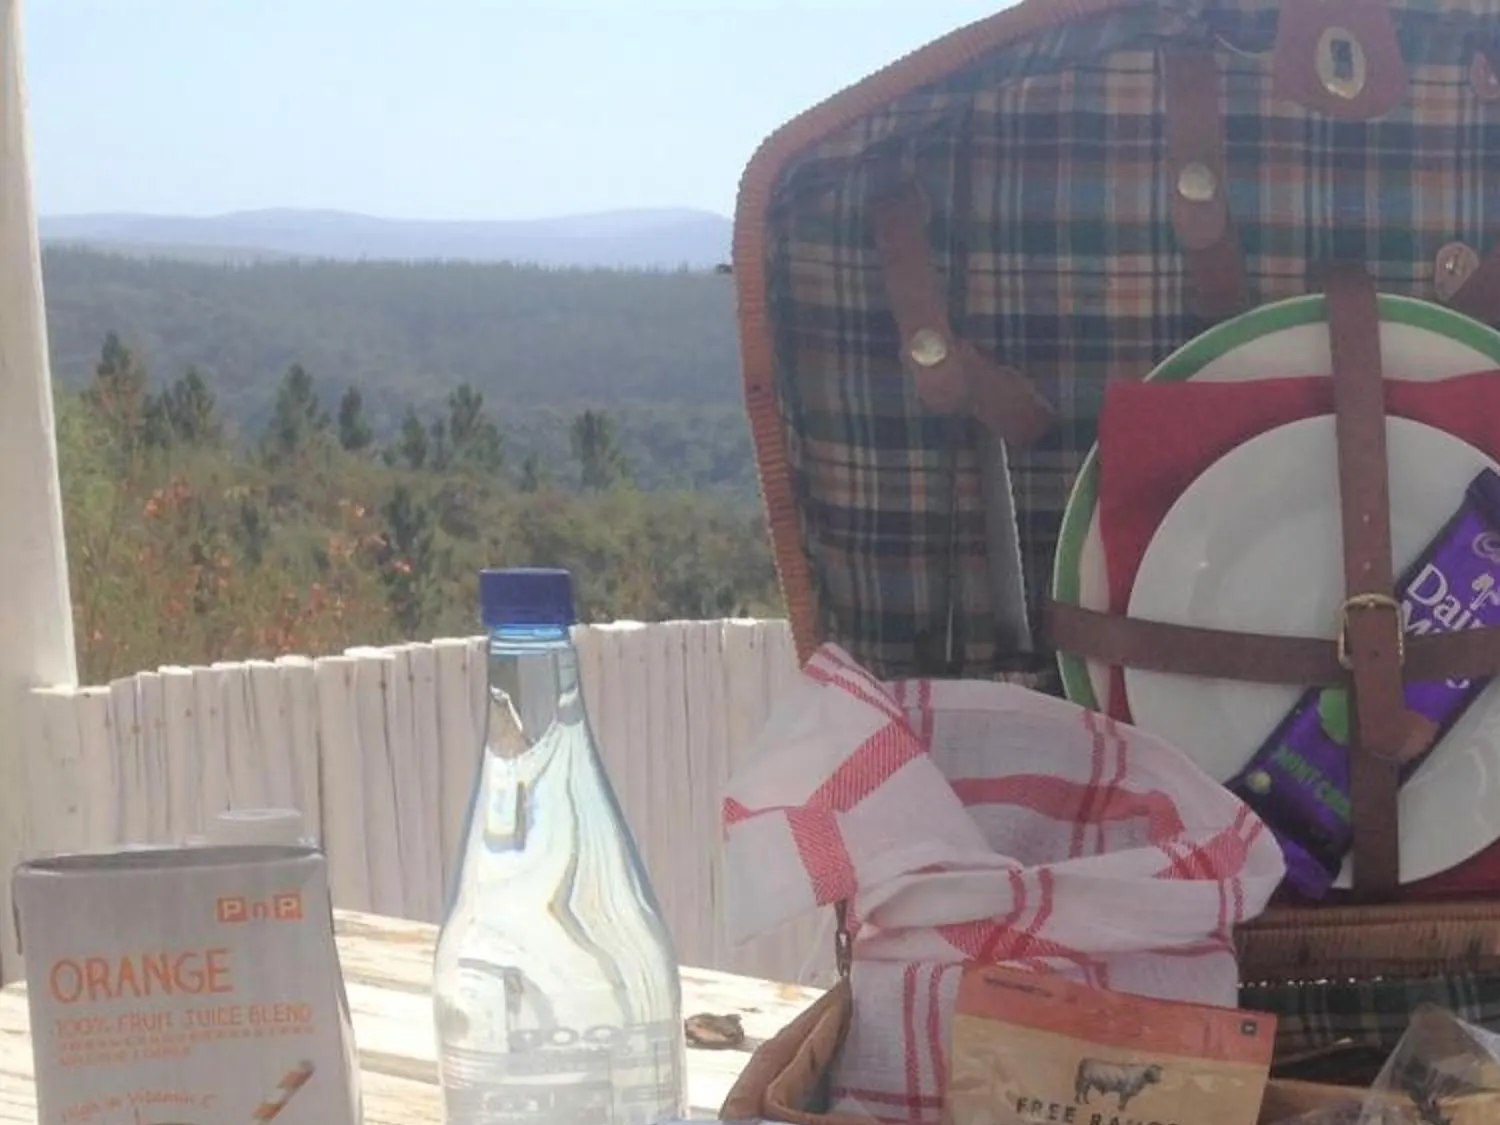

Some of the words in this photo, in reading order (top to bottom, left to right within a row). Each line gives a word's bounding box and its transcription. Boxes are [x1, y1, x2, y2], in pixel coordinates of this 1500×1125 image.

[219, 895, 301, 921] PnP
[50, 947, 234, 1004] ORANGE
[118, 1010, 173, 1034] FRUIT
[184, 1004, 242, 1027] JUICE
[248, 1002, 313, 1024] BLEND
[1016, 1097, 1077, 1124] FREE
